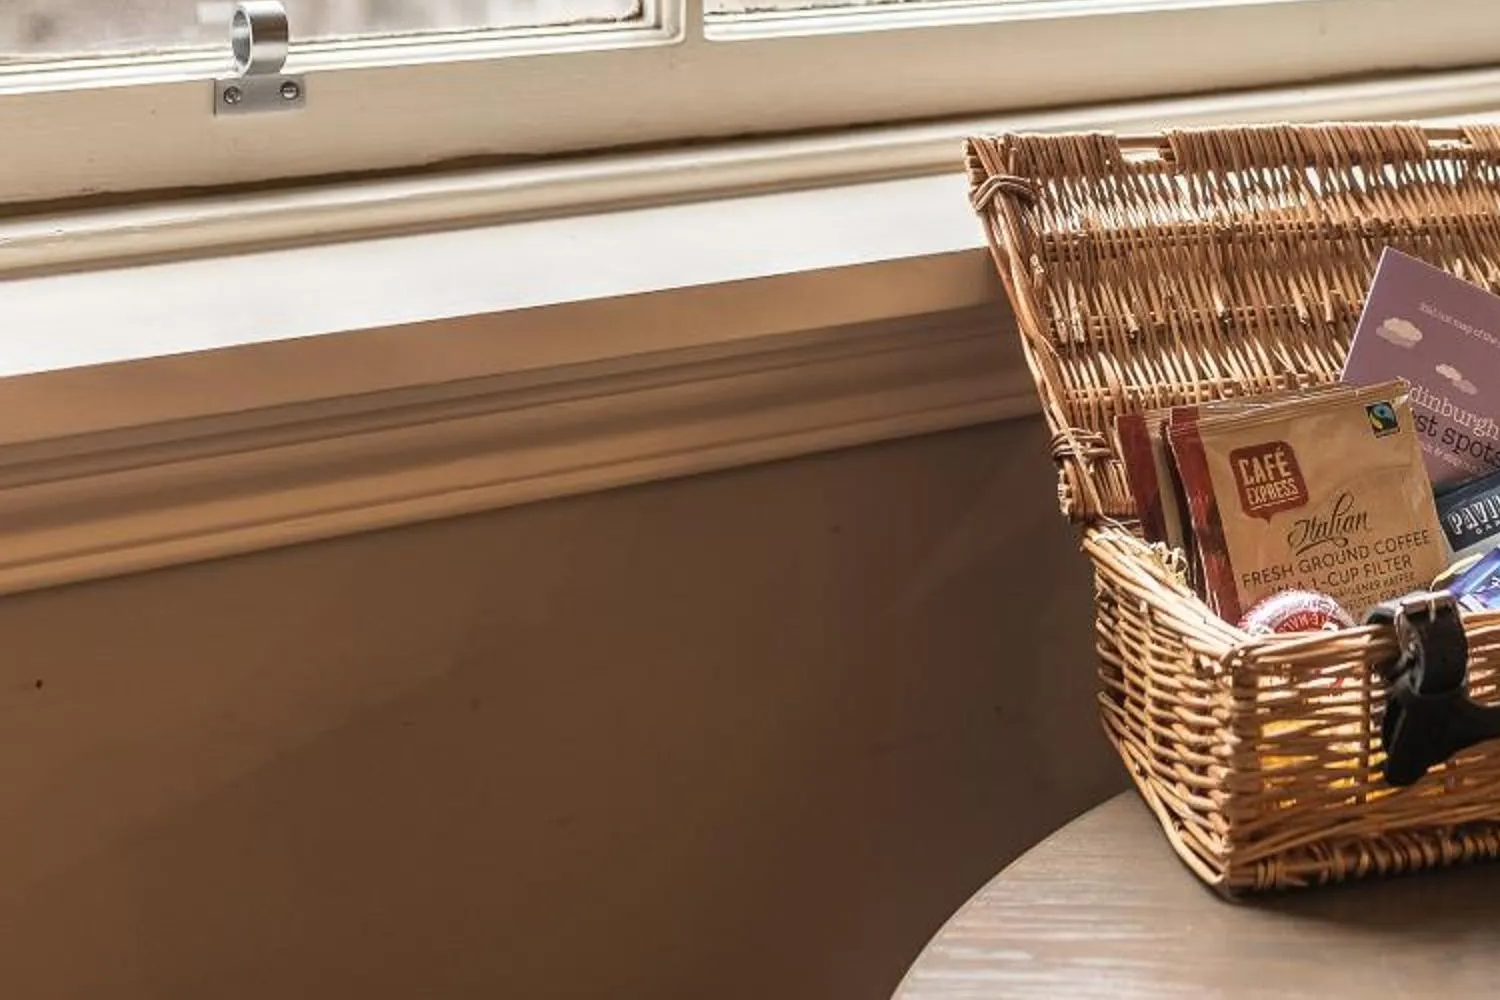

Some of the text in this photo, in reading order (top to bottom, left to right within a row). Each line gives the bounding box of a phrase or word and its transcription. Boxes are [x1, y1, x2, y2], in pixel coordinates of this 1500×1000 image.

[1238, 447, 1292, 486] CAFÉ
[1245, 478, 1300, 505] EXPRESS
[1287, 492, 1374, 556] Italian
[1241, 529, 1431, 588] FRESH GROUND COFFEE
[1311, 567, 1360, 591] 1-CUP
[1364, 554, 1413, 577] FILTER
